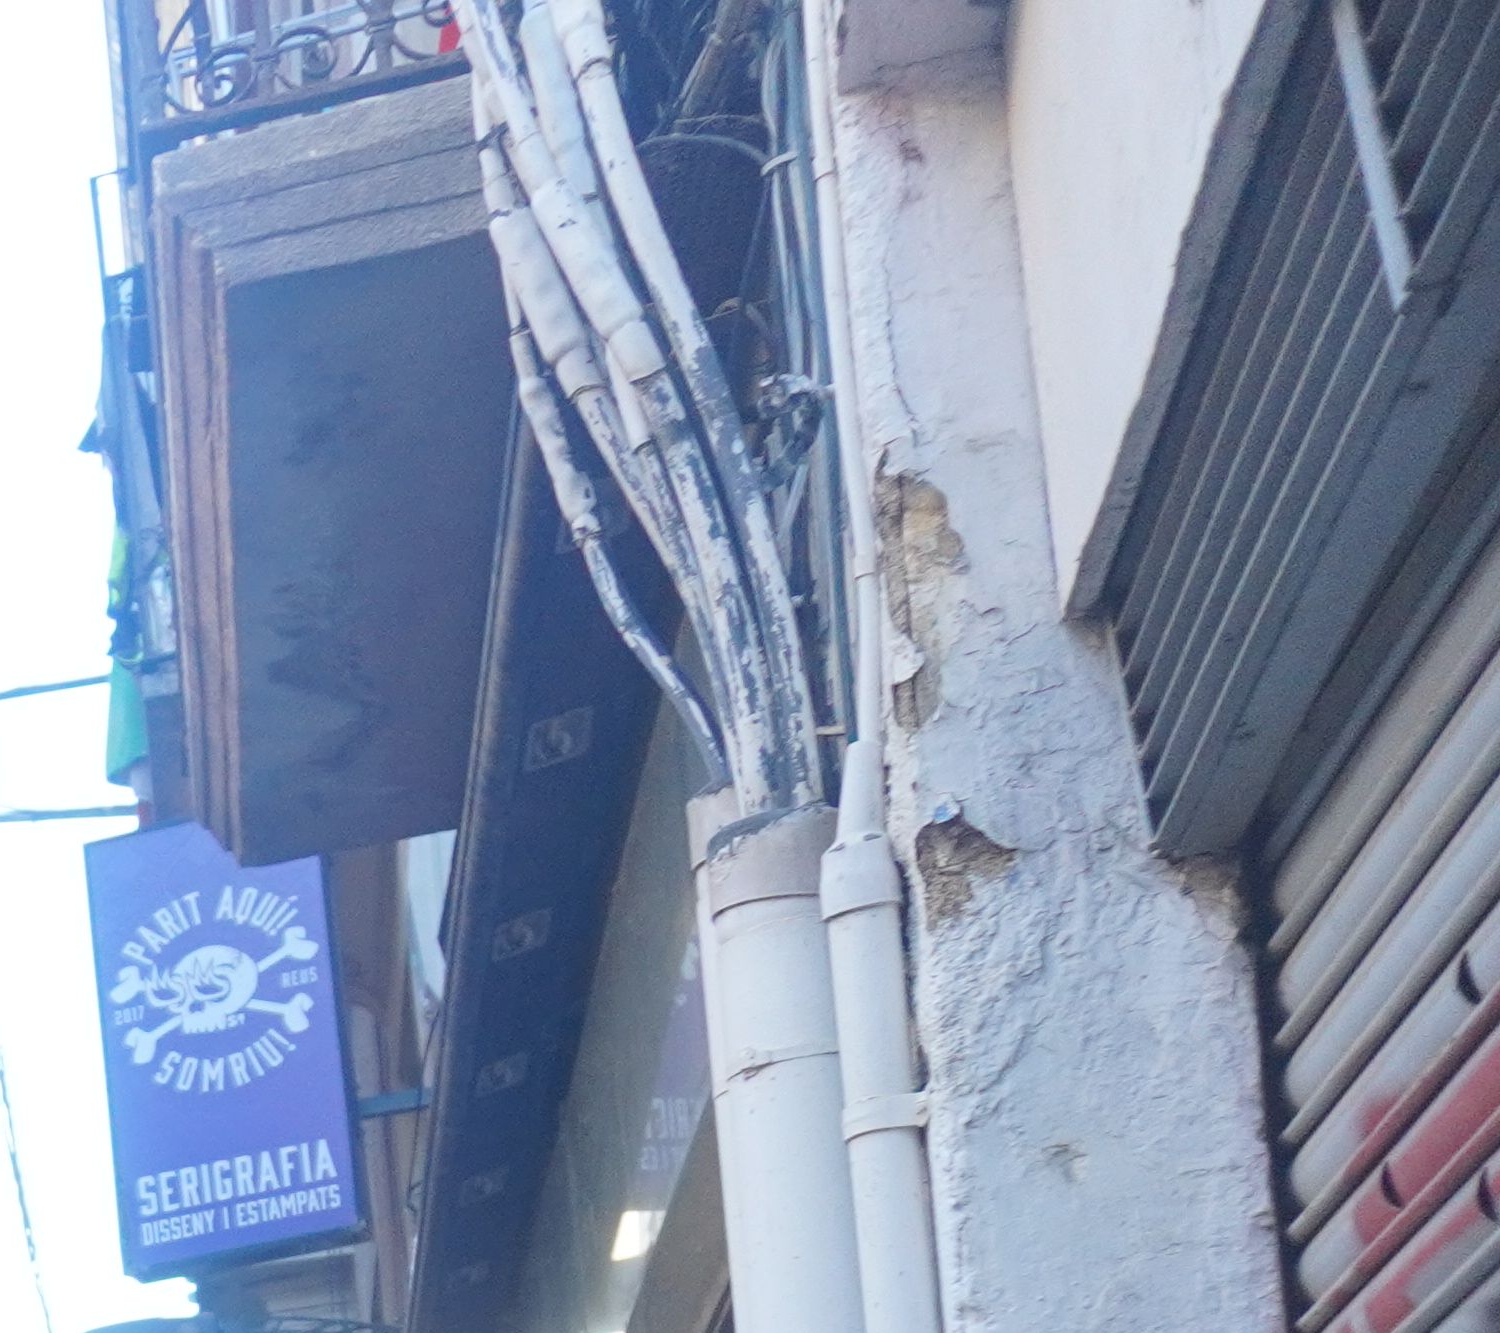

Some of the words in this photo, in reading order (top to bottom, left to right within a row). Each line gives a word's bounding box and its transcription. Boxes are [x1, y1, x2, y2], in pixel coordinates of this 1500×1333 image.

[122, 891, 202, 966] PARIT
[214, 885, 299, 937] AQUÍ!
[114, 1004, 145, 1027] 2017
[154, 1029, 297, 1092] SOMRIU!
[137, 1139, 339, 1217] SERIGRAFIA
[141, 1209, 215, 1246] DISSENY
[223, 1204, 231, 1229] I
[236, 1184, 342, 1228] ESTAMPATS
